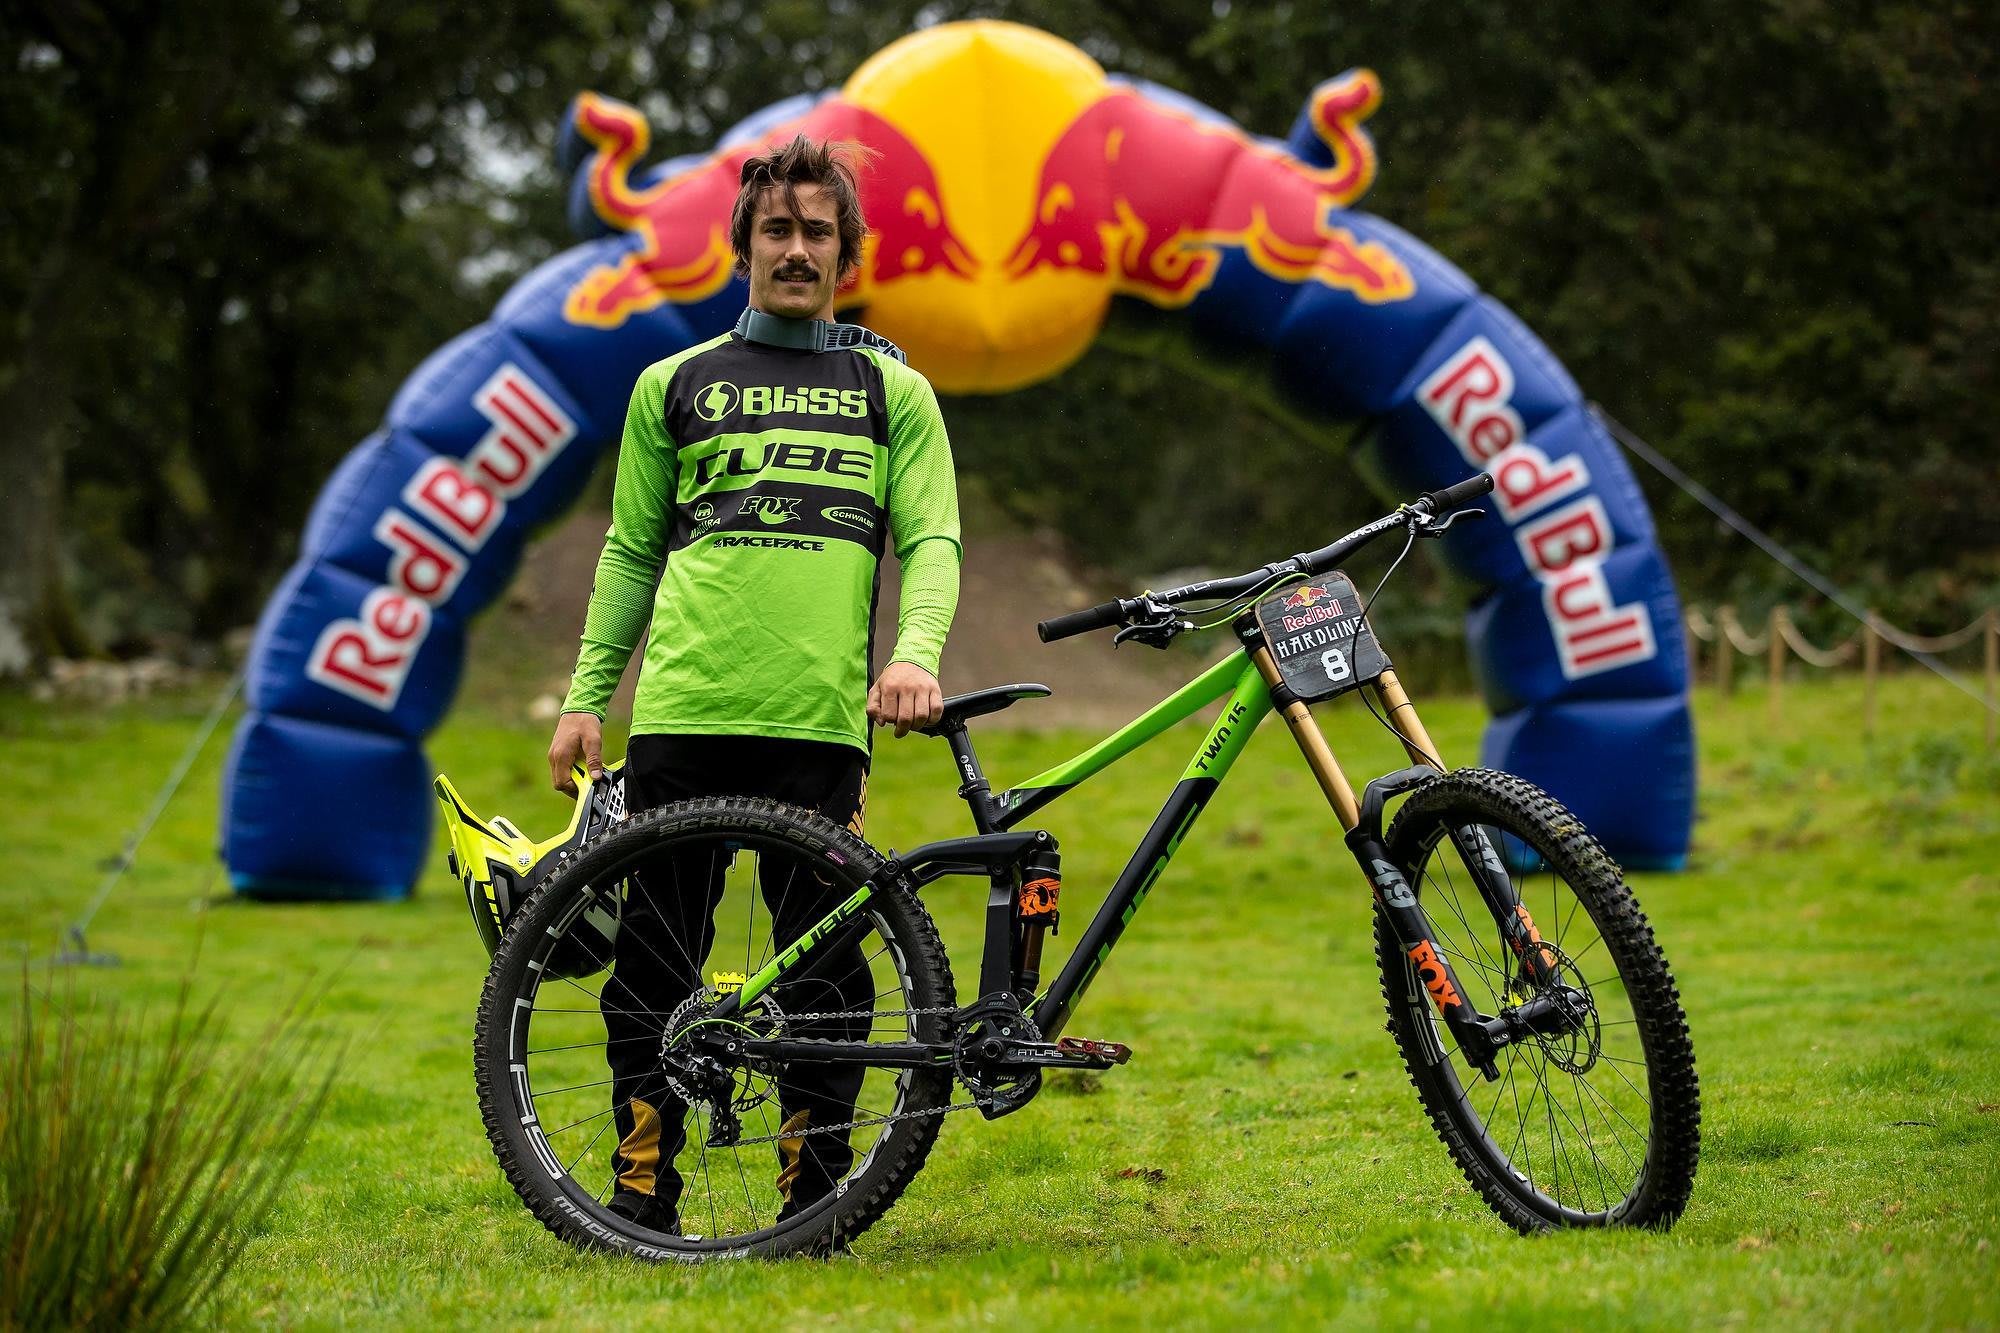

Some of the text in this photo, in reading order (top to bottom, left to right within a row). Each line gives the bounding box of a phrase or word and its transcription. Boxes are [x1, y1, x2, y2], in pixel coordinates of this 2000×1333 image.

[695, 443, 874, 486] CUBE
[738, 496, 802, 519] FOX
[832, 510, 875, 529] SCHWALBE
[1422, 345, 1650, 673] Red Bull
[312, 370, 570, 704] Red Bull
[722, 537, 825, 551] RACEFACE
[1282, 609, 1315, 632] Red
[1313, 599, 1343, 621] Bull
[1276, 616, 1367, 659] HARDLINE
[1320, 648, 1351, 682] 8
[1195, 701, 1248, 772] TWO 15
[659, 815, 826, 850] SCHWALBE
[1371, 858, 1418, 908] 49
[776, 895, 861, 973] CUBE
[1408, 939, 1462, 1016] FOX
[510, 884, 597, 1180] ATLAS
[1017, 1048, 1063, 1058] ATLAS
[553, 1195, 629, 1246] MAGIC
